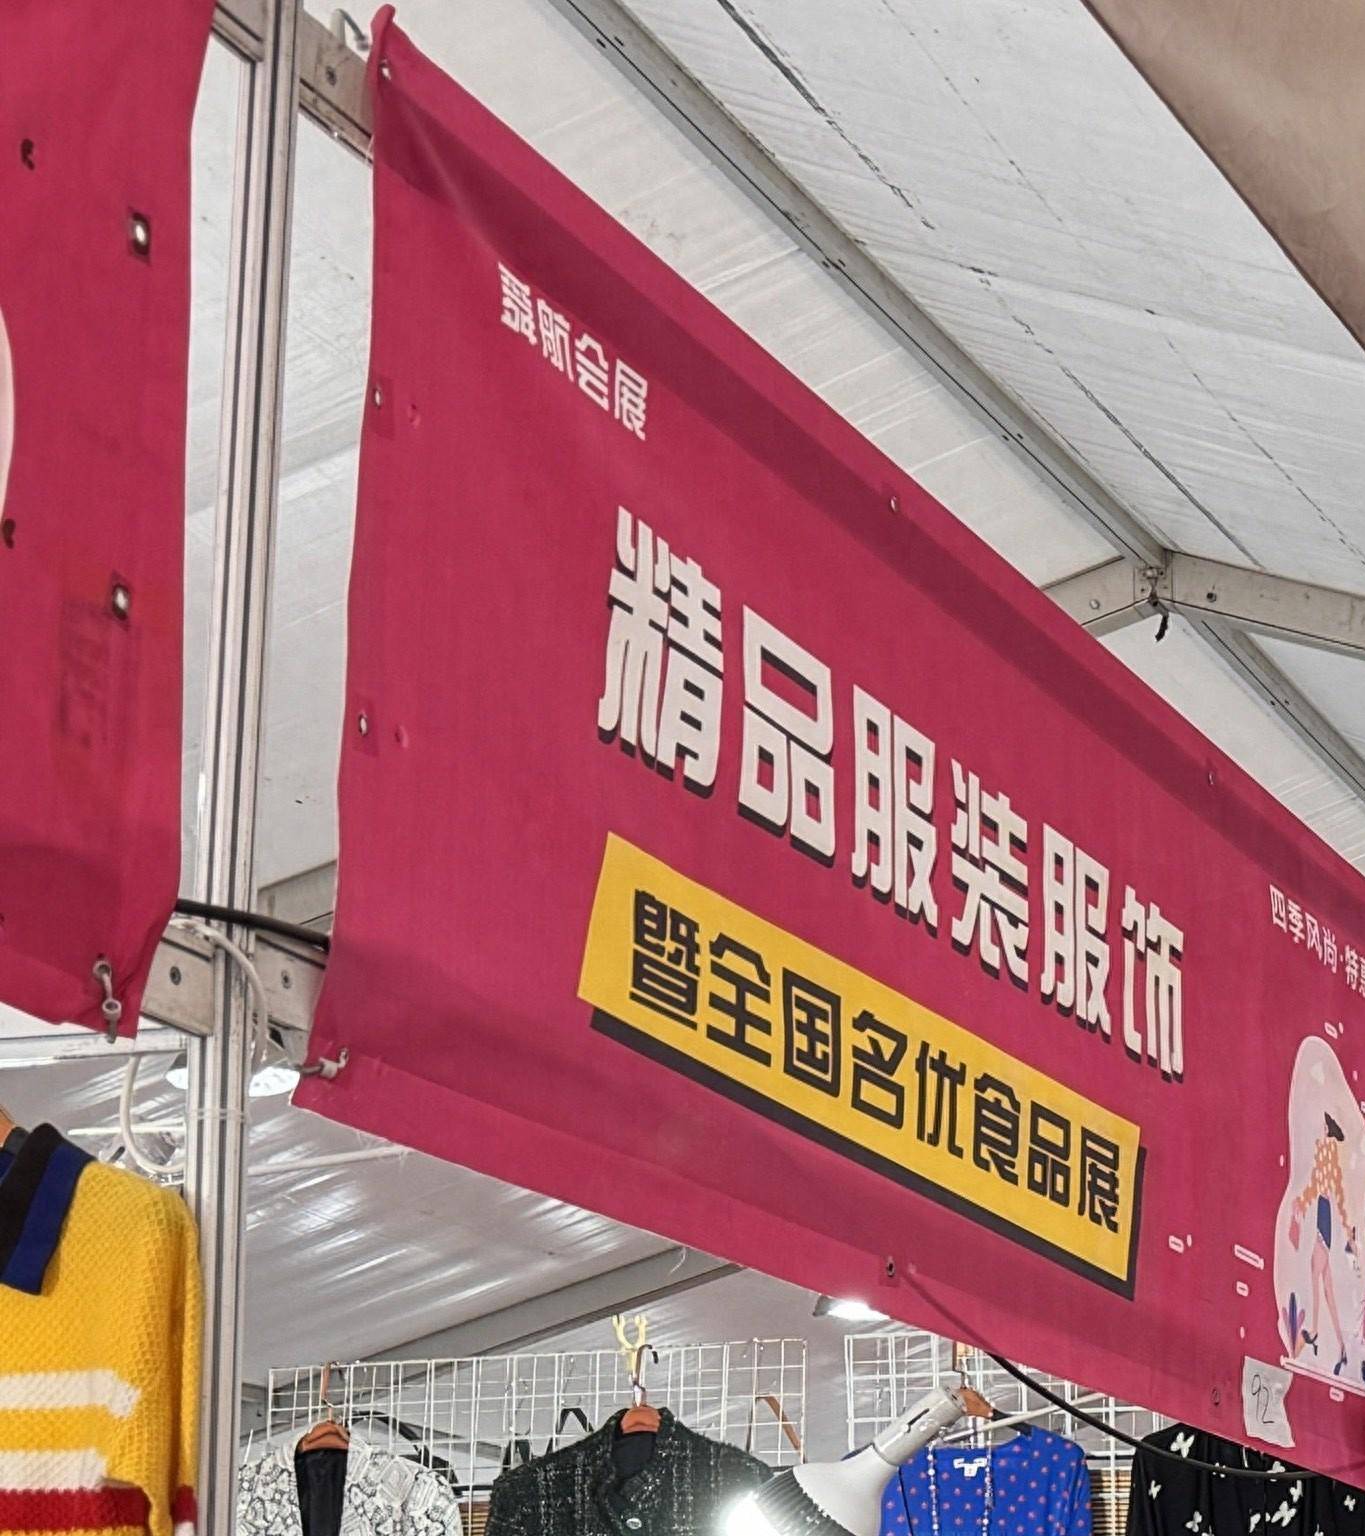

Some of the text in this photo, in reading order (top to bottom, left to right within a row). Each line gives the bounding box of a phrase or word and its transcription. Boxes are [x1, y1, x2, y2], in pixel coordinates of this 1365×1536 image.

[599, 506, 1186, 1078] 精品服装服饰
[630, 889, 1120, 1235] 暨全国名优食品展
[1251, 1374, 1275, 1424] 92
